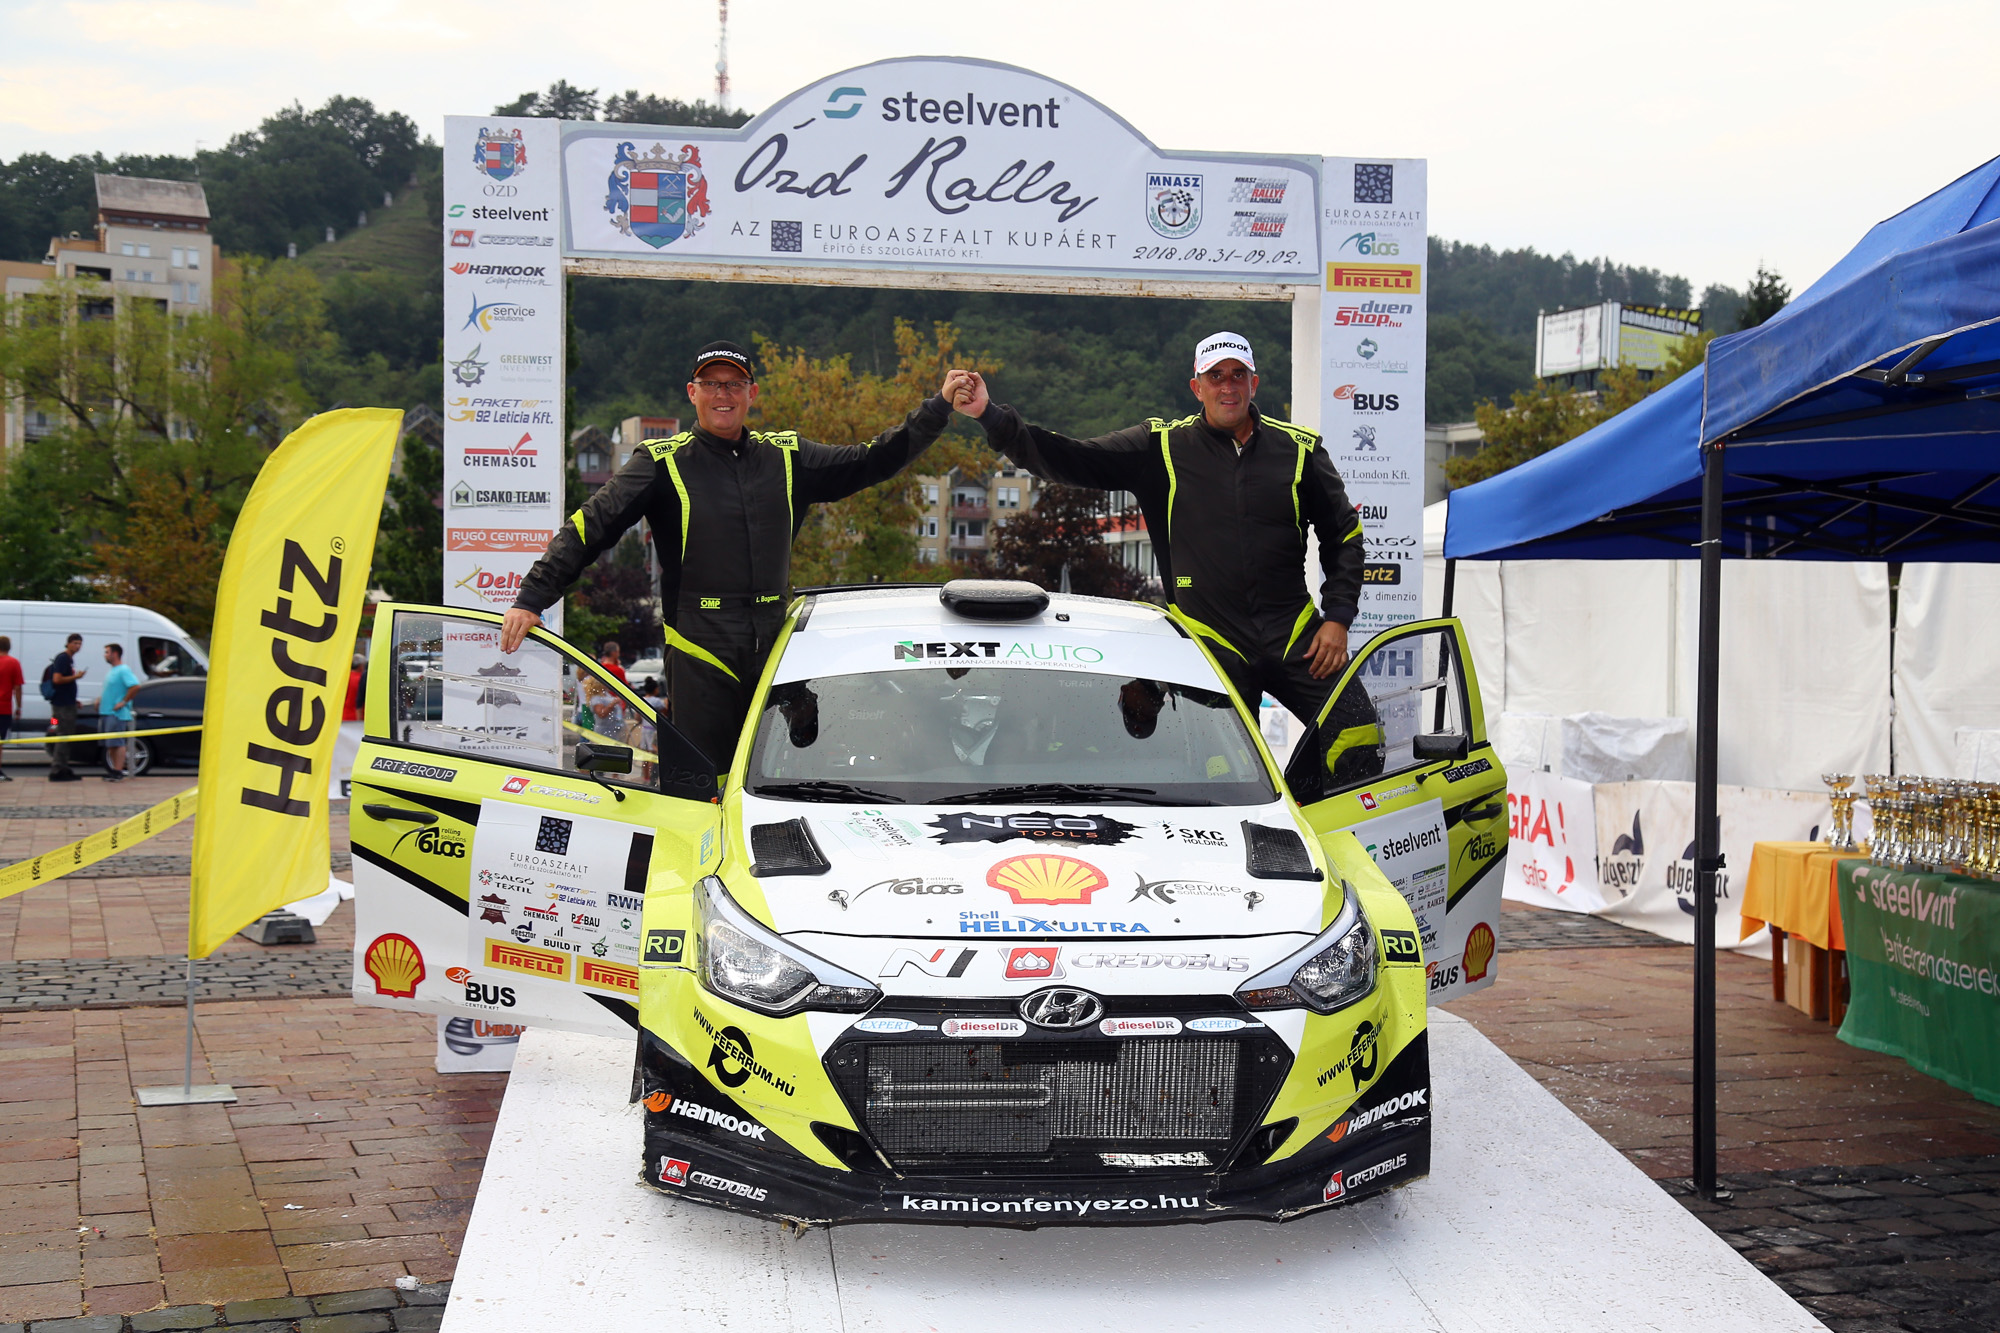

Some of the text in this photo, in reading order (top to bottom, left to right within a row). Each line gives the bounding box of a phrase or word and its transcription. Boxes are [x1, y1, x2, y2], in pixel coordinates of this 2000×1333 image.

[882, 91, 1060, 128] steelvent
[734, 118, 1098, 223] Ózd Rally
[1150, 175, 1200, 187] MNASZ
[483, 182, 517, 197] ÓZD
[1252, 189, 1285, 198] RALLYE
[472, 206, 549, 221] steelvent
[1325, 209, 1421, 220] EUROASZFALT
[1252, 223, 1285, 232] RALLYE
[478, 235, 554, 247] CREDOBUS
[731, 221, 1117, 249] AZ EUROASZFALT KUPÁÉRT
[860, 243, 874, 255] ÉS
[878, 244, 956, 258] SZOLGÁLTATÓ
[1358, 239, 1399, 255] 6LOG
[1334, 268, 1413, 289] PIRELLI
[493, 306, 536, 317] service
[1361, 300, 1412, 314] duen
[500, 355, 552, 365] GREENWEST
[1353, 394, 1399, 411] BUS
[476, 410, 553, 424] 92 Leticia Kft.
[1295, 434, 1312, 446] OMP
[655, 444, 673, 454] OMP
[463, 456, 537, 468] CHEMASOL
[1352, 470, 1410, 479] London Kft.
[476, 490, 547, 503] CSAKO-TEAM
[1359, 506, 1388, 519] -BAU
[452, 530, 548, 542] RUGÓ CENTRUM
[1363, 535, 1416, 547] ALGÓ
[1364, 551, 1414, 560] EXTIL
[477, 571, 523, 589] Delt
[1363, 567, 1394, 581] ertz
[1177, 578, 1192, 586] OMP
[1363, 591, 1370, 600] &
[700, 599, 720, 608] OMP
[1387, 613, 1416, 621] green
[446, 633, 493, 642] INTEGRA
[894, 641, 1103, 663] NEXT AUTO
[1351, 650, 1413, 676] WH
[241, 538, 342, 818] Hertz
[373, 759, 455, 781] ART GROUP
[1446, 760, 1490, 782] ART GROUP
[529, 784, 602, 805] CREDOBUS
[961, 816, 1098, 830] NEO
[1507, 793, 1554, 847] GRA
[441, 827, 461, 836] rolling
[441, 833, 467, 843] solutions
[872, 818, 913, 847] steelvent
[1017, 830, 1098, 838] TOOLS
[1180, 828, 1225, 841] SKC
[418, 833, 465, 858] 6LOG
[1183, 838, 1229, 847] HOLDING
[1383, 824, 1441, 860] steelvent
[1471, 841, 1495, 861] 6LOG
[510, 852, 588, 874] EUROASZFALT
[494, 872, 534, 886] SALGÓ
[495, 882, 532, 894] TEXTIL
[893, 882, 964, 895] 6LOG
[1174, 883, 1242, 894] service
[1177, 890, 1226, 898] solutions
[523, 910, 558, 923] CHEMASOL
[571, 913, 600, 928] P1-BAU
[959, 911, 999, 920] Shell
[959, 920, 1150, 933] HELIX ULTRA
[544, 938, 571, 951] BUILD
[573, 945, 582, 953] IT
[646, 936, 682, 954] RD
[1383, 936, 1417, 955] RD
[492, 945, 564, 975] PIRELLI
[1071, 952, 1250, 973] CREDOBUS
[583, 962, 639, 991] PIREL
[1430, 965, 1459, 990] BUS
[465, 982, 516, 1007] BUS
[860, 1021, 913, 1030] EXPERT
[960, 1022, 1019, 1031] dieselDR
[1118, 1021, 1175, 1030] dieselDR
[1191, 1020, 1241, 1029] EXPERT
[693, 1006, 795, 1096] WWW.FEFERRUM.HU
[1347, 1153, 1407, 1189] CREDOBUS
[690, 1170, 768, 1202] CREDOBUS
[902, 1194, 1200, 1216] kamionfenyezo.hu
